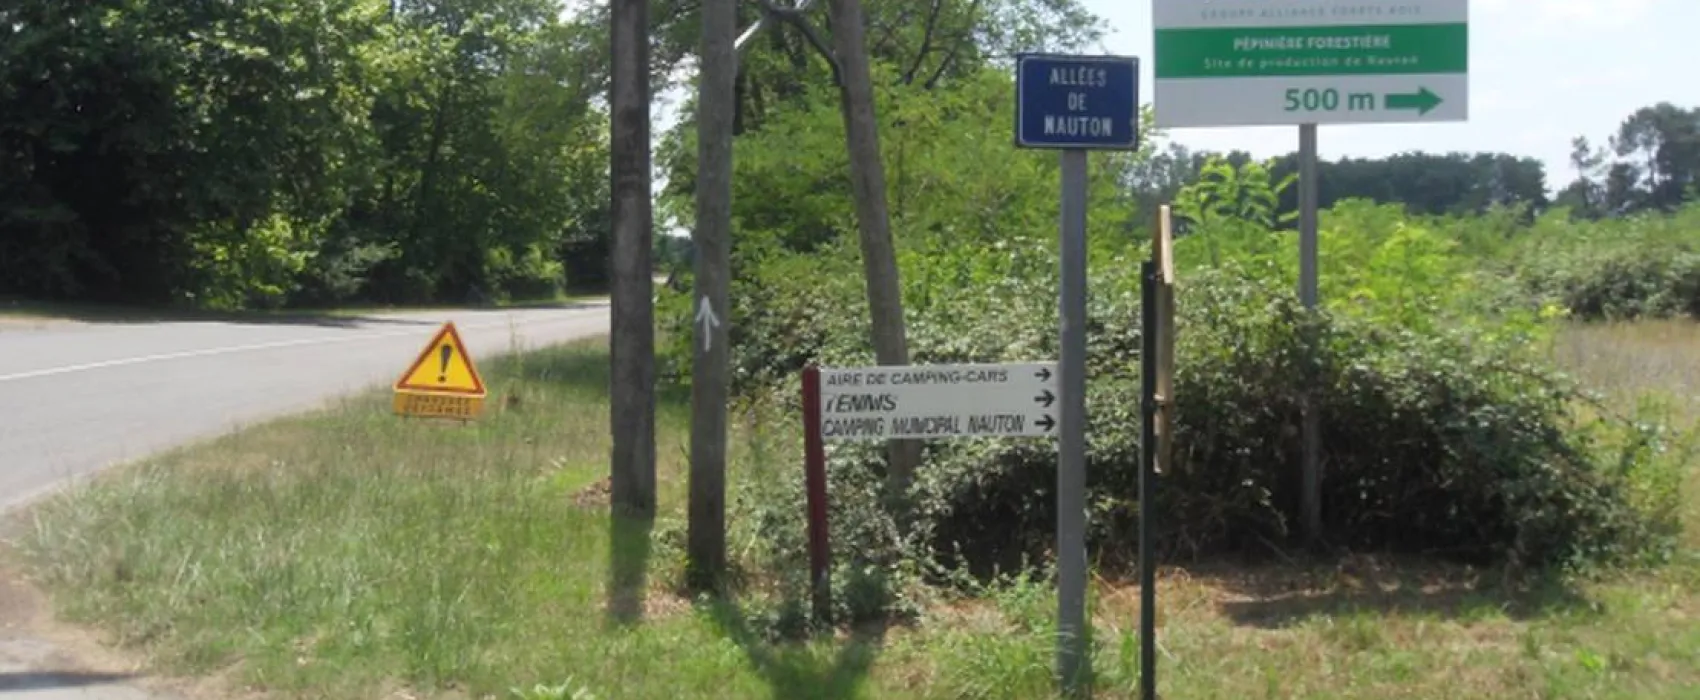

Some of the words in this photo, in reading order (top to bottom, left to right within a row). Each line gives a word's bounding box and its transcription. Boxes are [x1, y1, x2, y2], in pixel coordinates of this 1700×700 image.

[1204, 57, 1232, 69] Site
[1049, 65, 1107, 88] ALLÉES
[1067, 91, 1088, 111] DE
[1284, 88, 1340, 111] 500
[1347, 92, 1375, 111] m
[1043, 115, 1113, 137] NAUTON
[826, 373, 861, 386] AIRE
[865, 372, 886, 385] DE
[890, 369, 1009, 385] CAMPING-CARS
[821, 418, 885, 437] CAMPING
[967, 414, 1025, 434] NAUTON
